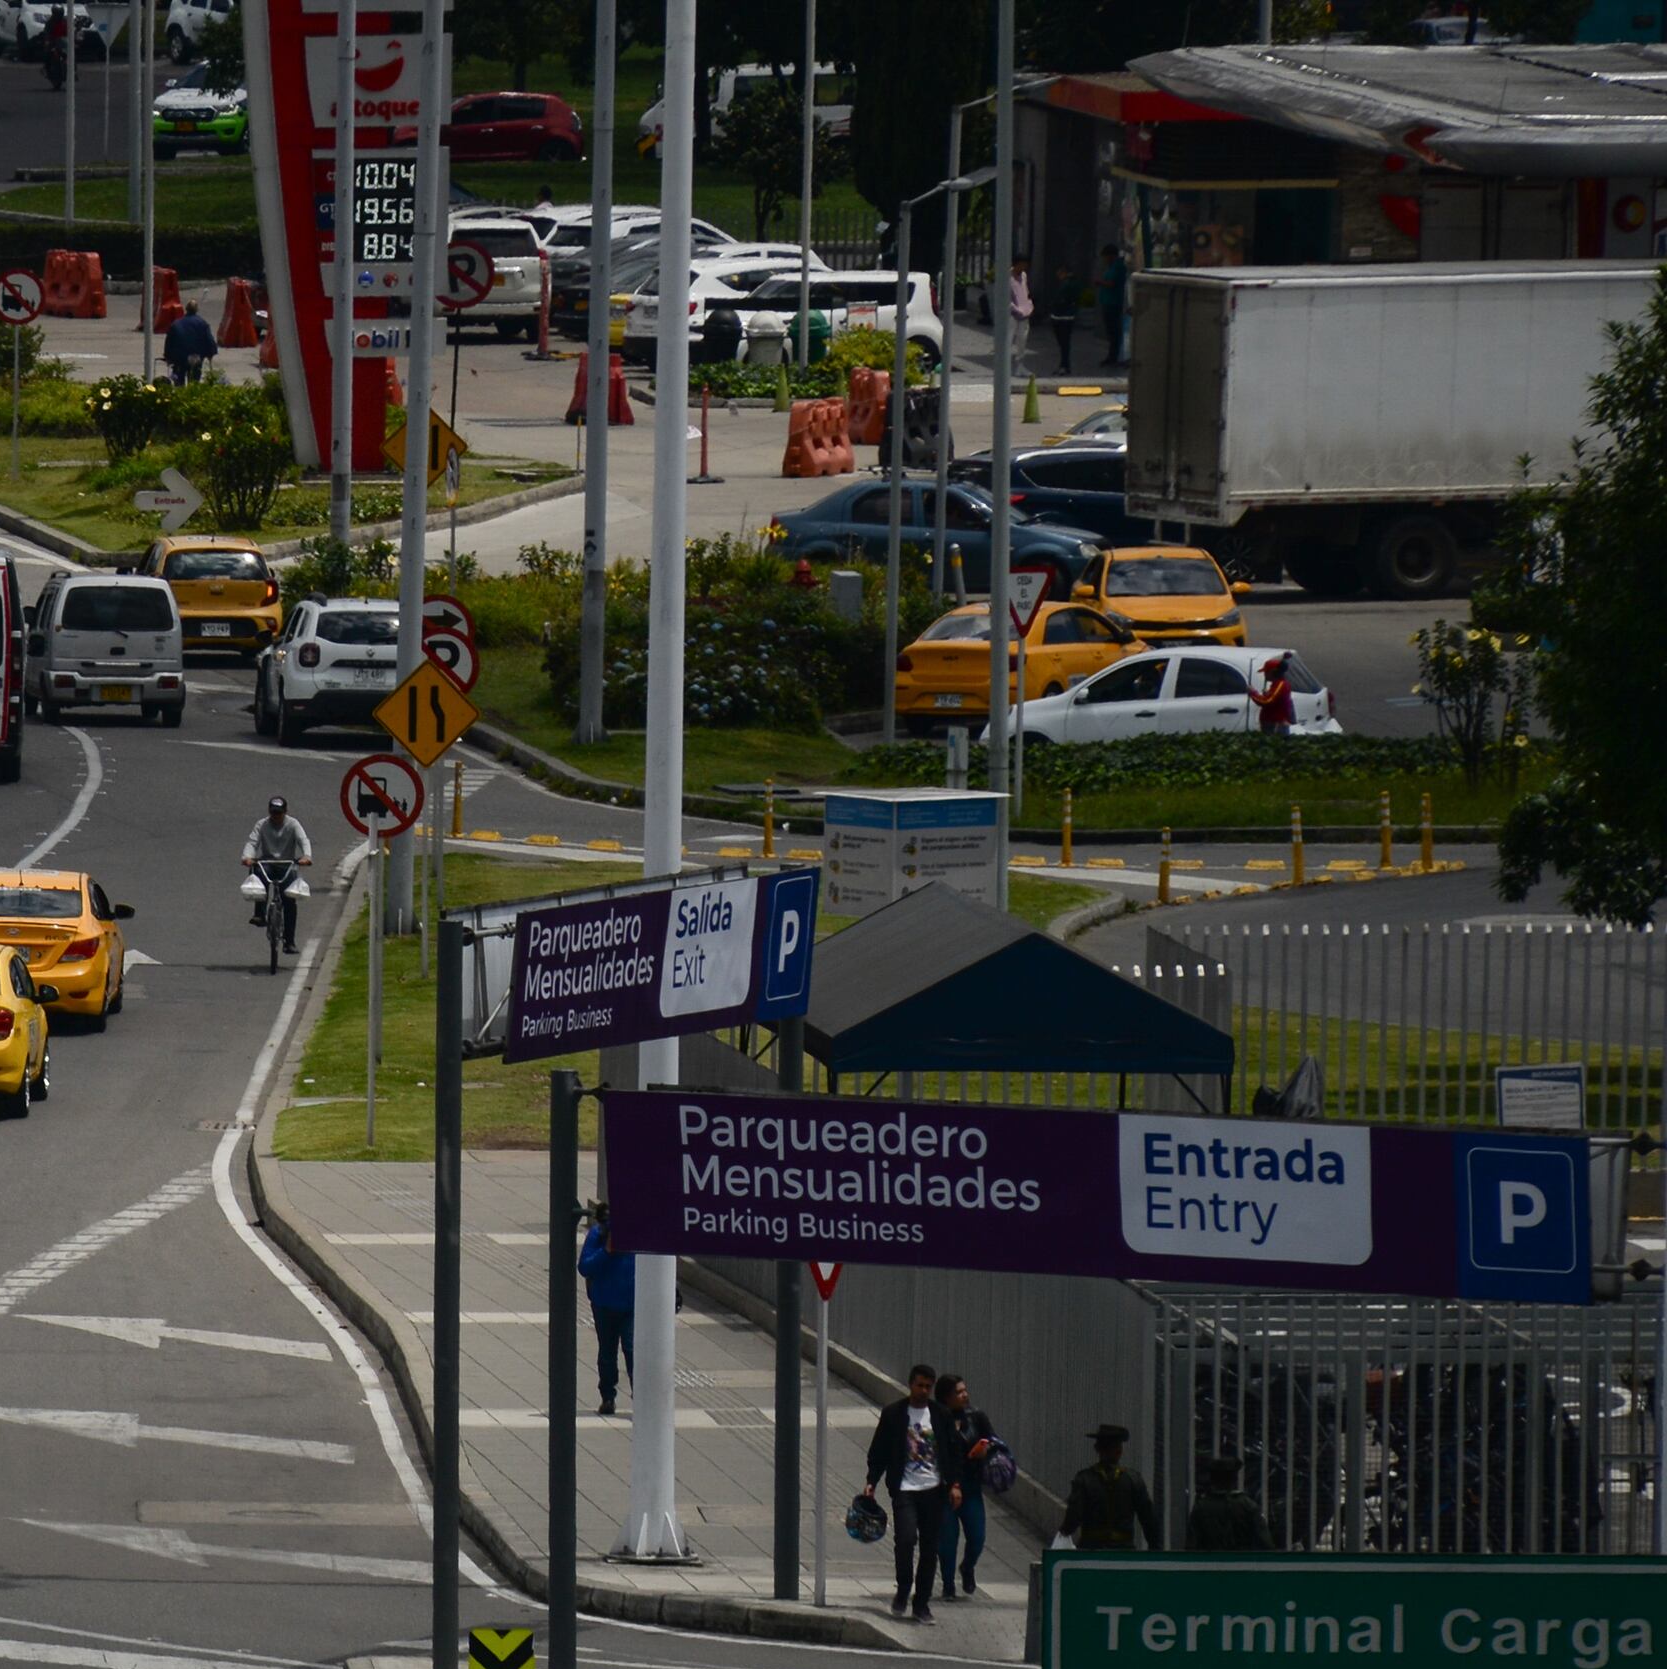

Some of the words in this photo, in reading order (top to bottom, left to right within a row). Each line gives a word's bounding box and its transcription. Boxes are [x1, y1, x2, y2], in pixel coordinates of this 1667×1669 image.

[351, 326, 399, 348] obil
[528, 908, 641, 963] Parqueadero
[675, 890, 732, 939] Salida
[778, 909, 800, 973] P
[524, 946, 655, 1002] Mensualidades
[672, 948, 705, 988] Exit
[522, 1014, 563, 1038] Parking
[567, 1005, 612, 1032] Business
[678, 1104, 988, 1160] Parqueadero
[1143, 1132, 1345, 1185] Entrada
[681, 1154, 1042, 1212] Mensualidades
[683, 1206, 788, 1243] Parking
[798, 1213, 925, 1244] Business
[1146, 1186, 1278, 1245] Entry
[1498, 1180, 1548, 1244] P
[1096, 1600, 1405, 1653] Terminal
[1440, 1608, 1653, 1669] Carga
